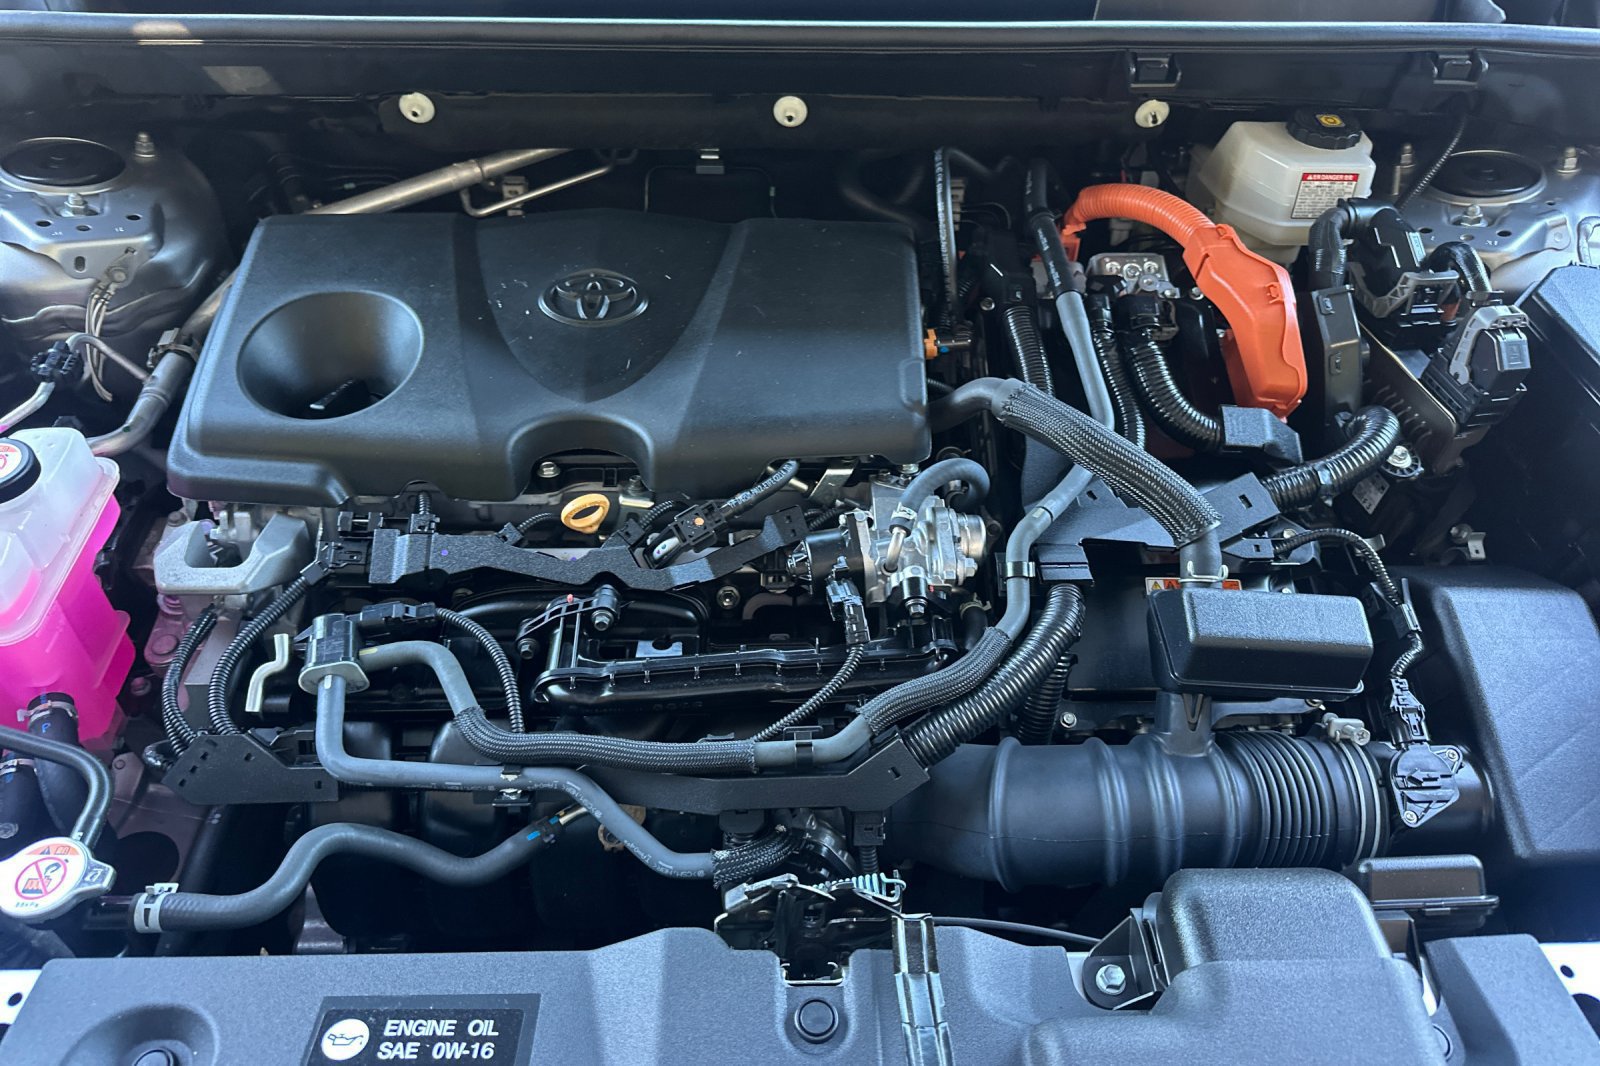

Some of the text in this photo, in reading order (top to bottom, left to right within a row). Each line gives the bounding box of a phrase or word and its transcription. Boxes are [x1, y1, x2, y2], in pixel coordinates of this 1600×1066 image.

[383, 1019, 499, 1037] ENGINE OIL
[376, 1041, 496, 1060] SAE 0W-16
